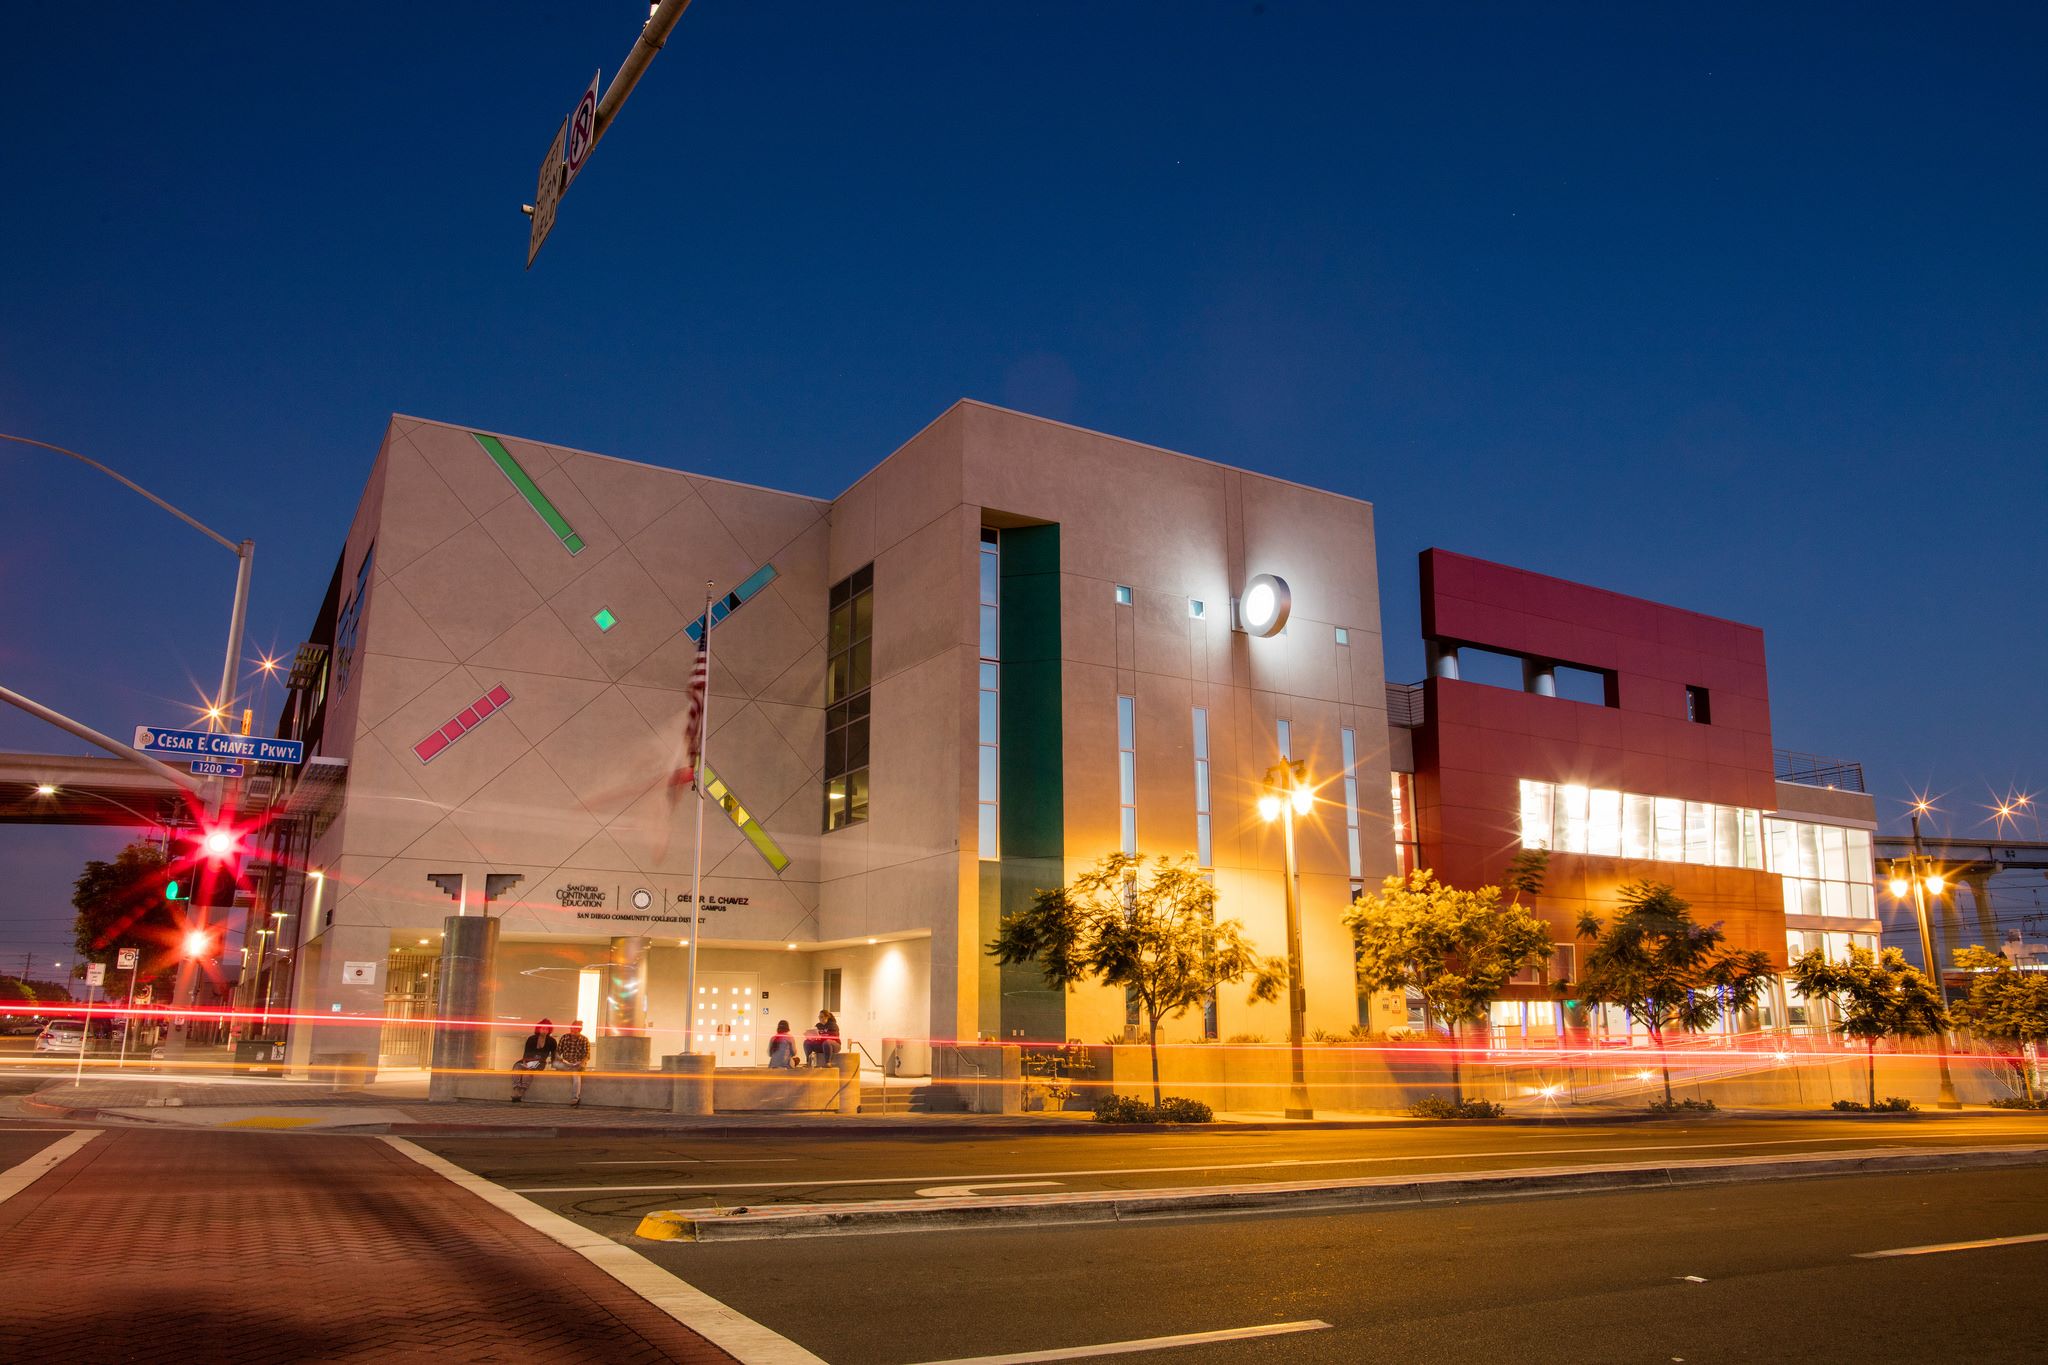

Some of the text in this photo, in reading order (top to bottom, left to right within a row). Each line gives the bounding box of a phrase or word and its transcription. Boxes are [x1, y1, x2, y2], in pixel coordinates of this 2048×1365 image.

[158, 733, 297, 759] CESAR E. CHAVEZ PKWY.
[199, 763, 222, 774] 1200
[556, 889, 606, 901] CONTINUING
[677, 895, 705, 903] CESR
[718, 897, 749, 905] CHAVEZ
[562, 899, 602, 908] EDUCATION
